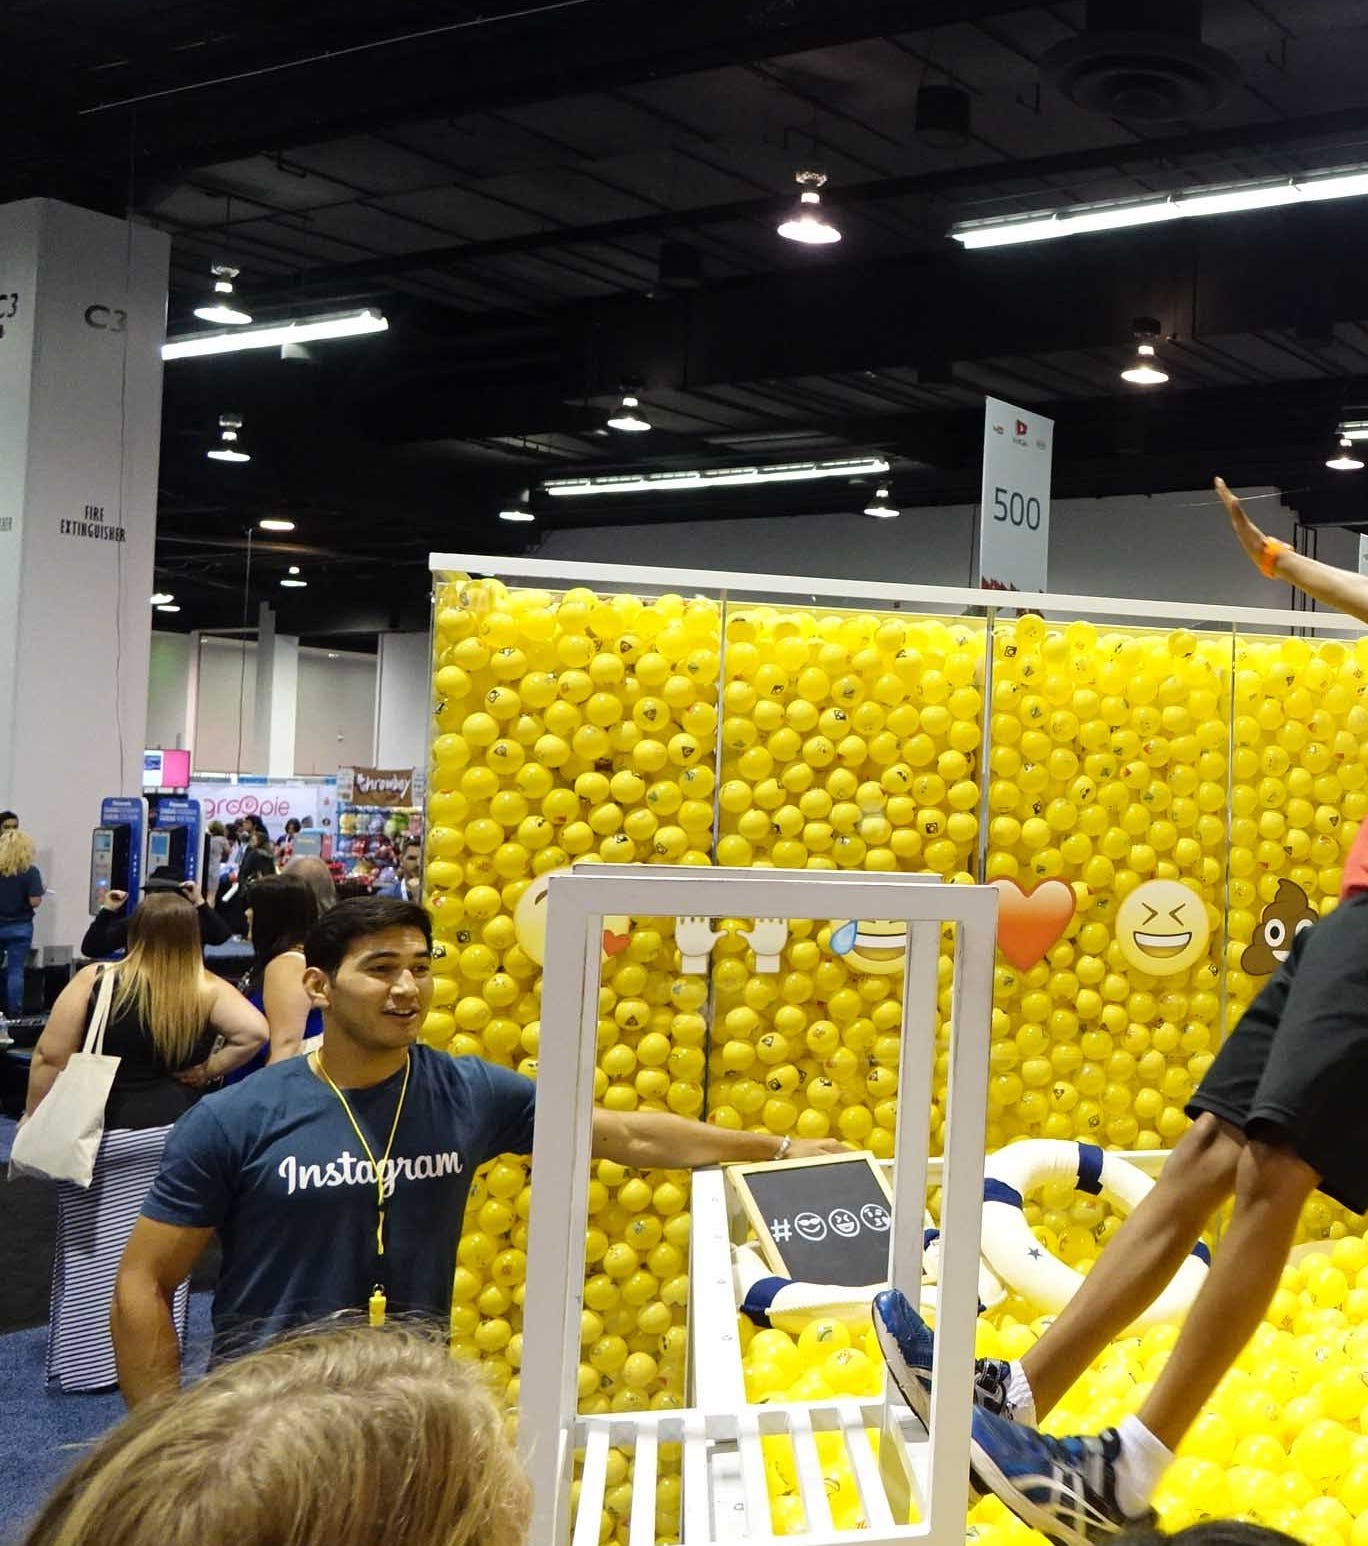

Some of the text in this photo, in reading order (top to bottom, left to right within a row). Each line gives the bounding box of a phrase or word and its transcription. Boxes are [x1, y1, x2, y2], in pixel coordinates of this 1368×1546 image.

[84, 304, 128, 332] C3
[84, 505, 104, 522] FIRE
[993, 486, 1041, 530] 500
[60, 519, 126, 542] EXTINGUISHER
[278, 1151, 463, 1199] Instagram
